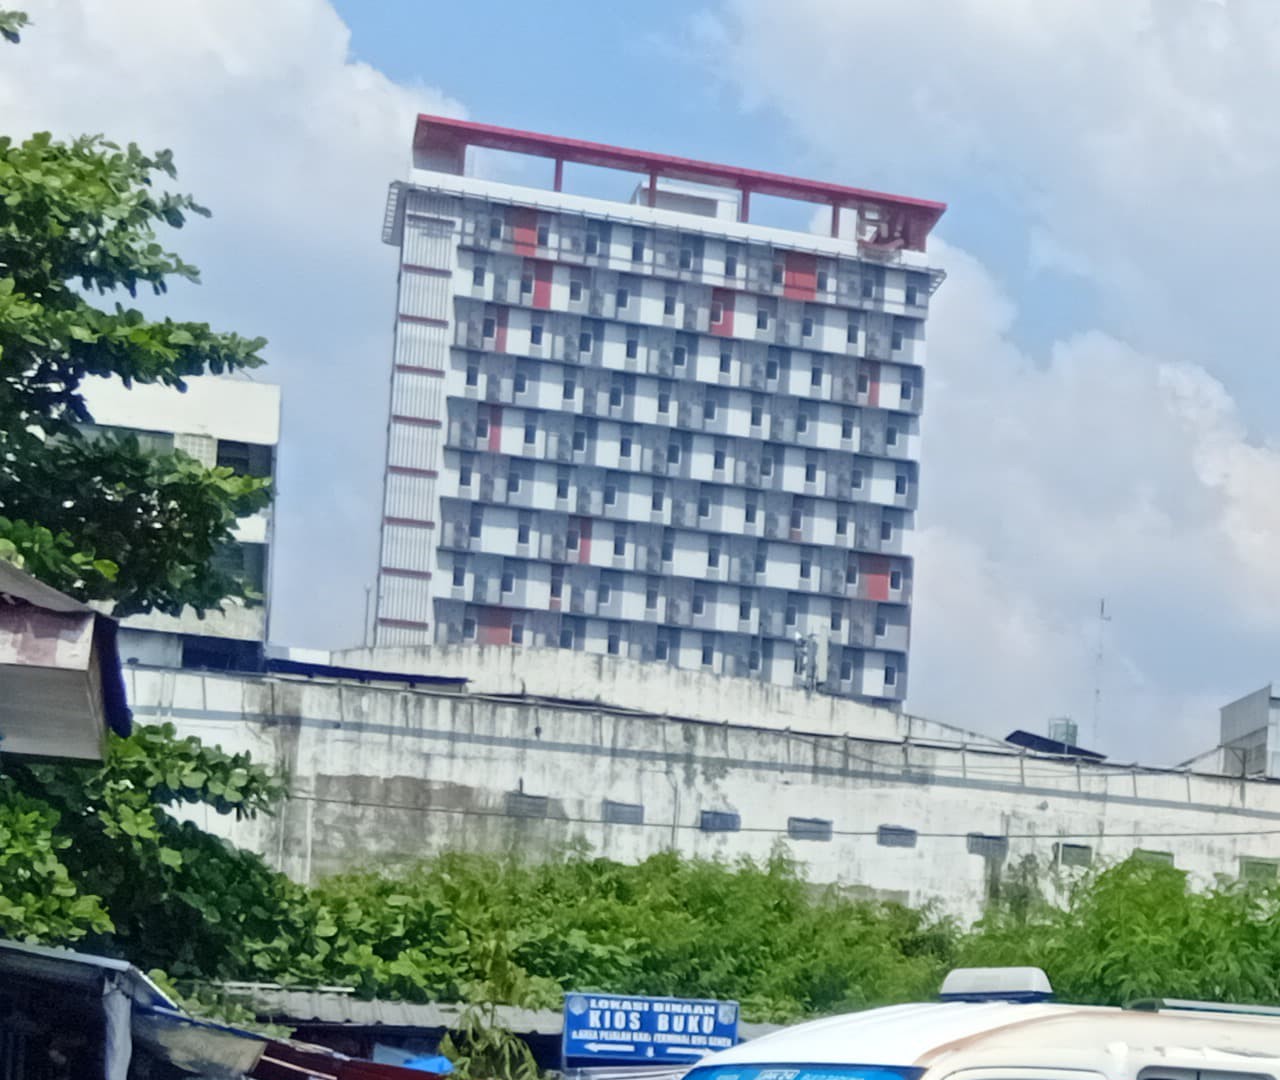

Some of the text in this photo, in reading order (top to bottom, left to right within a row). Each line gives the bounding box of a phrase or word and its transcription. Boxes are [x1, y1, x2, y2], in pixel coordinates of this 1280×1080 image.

[590, 999, 715, 1015] LOKASI BINAAN
[589, 1010, 715, 1034] KIOS BUKU
